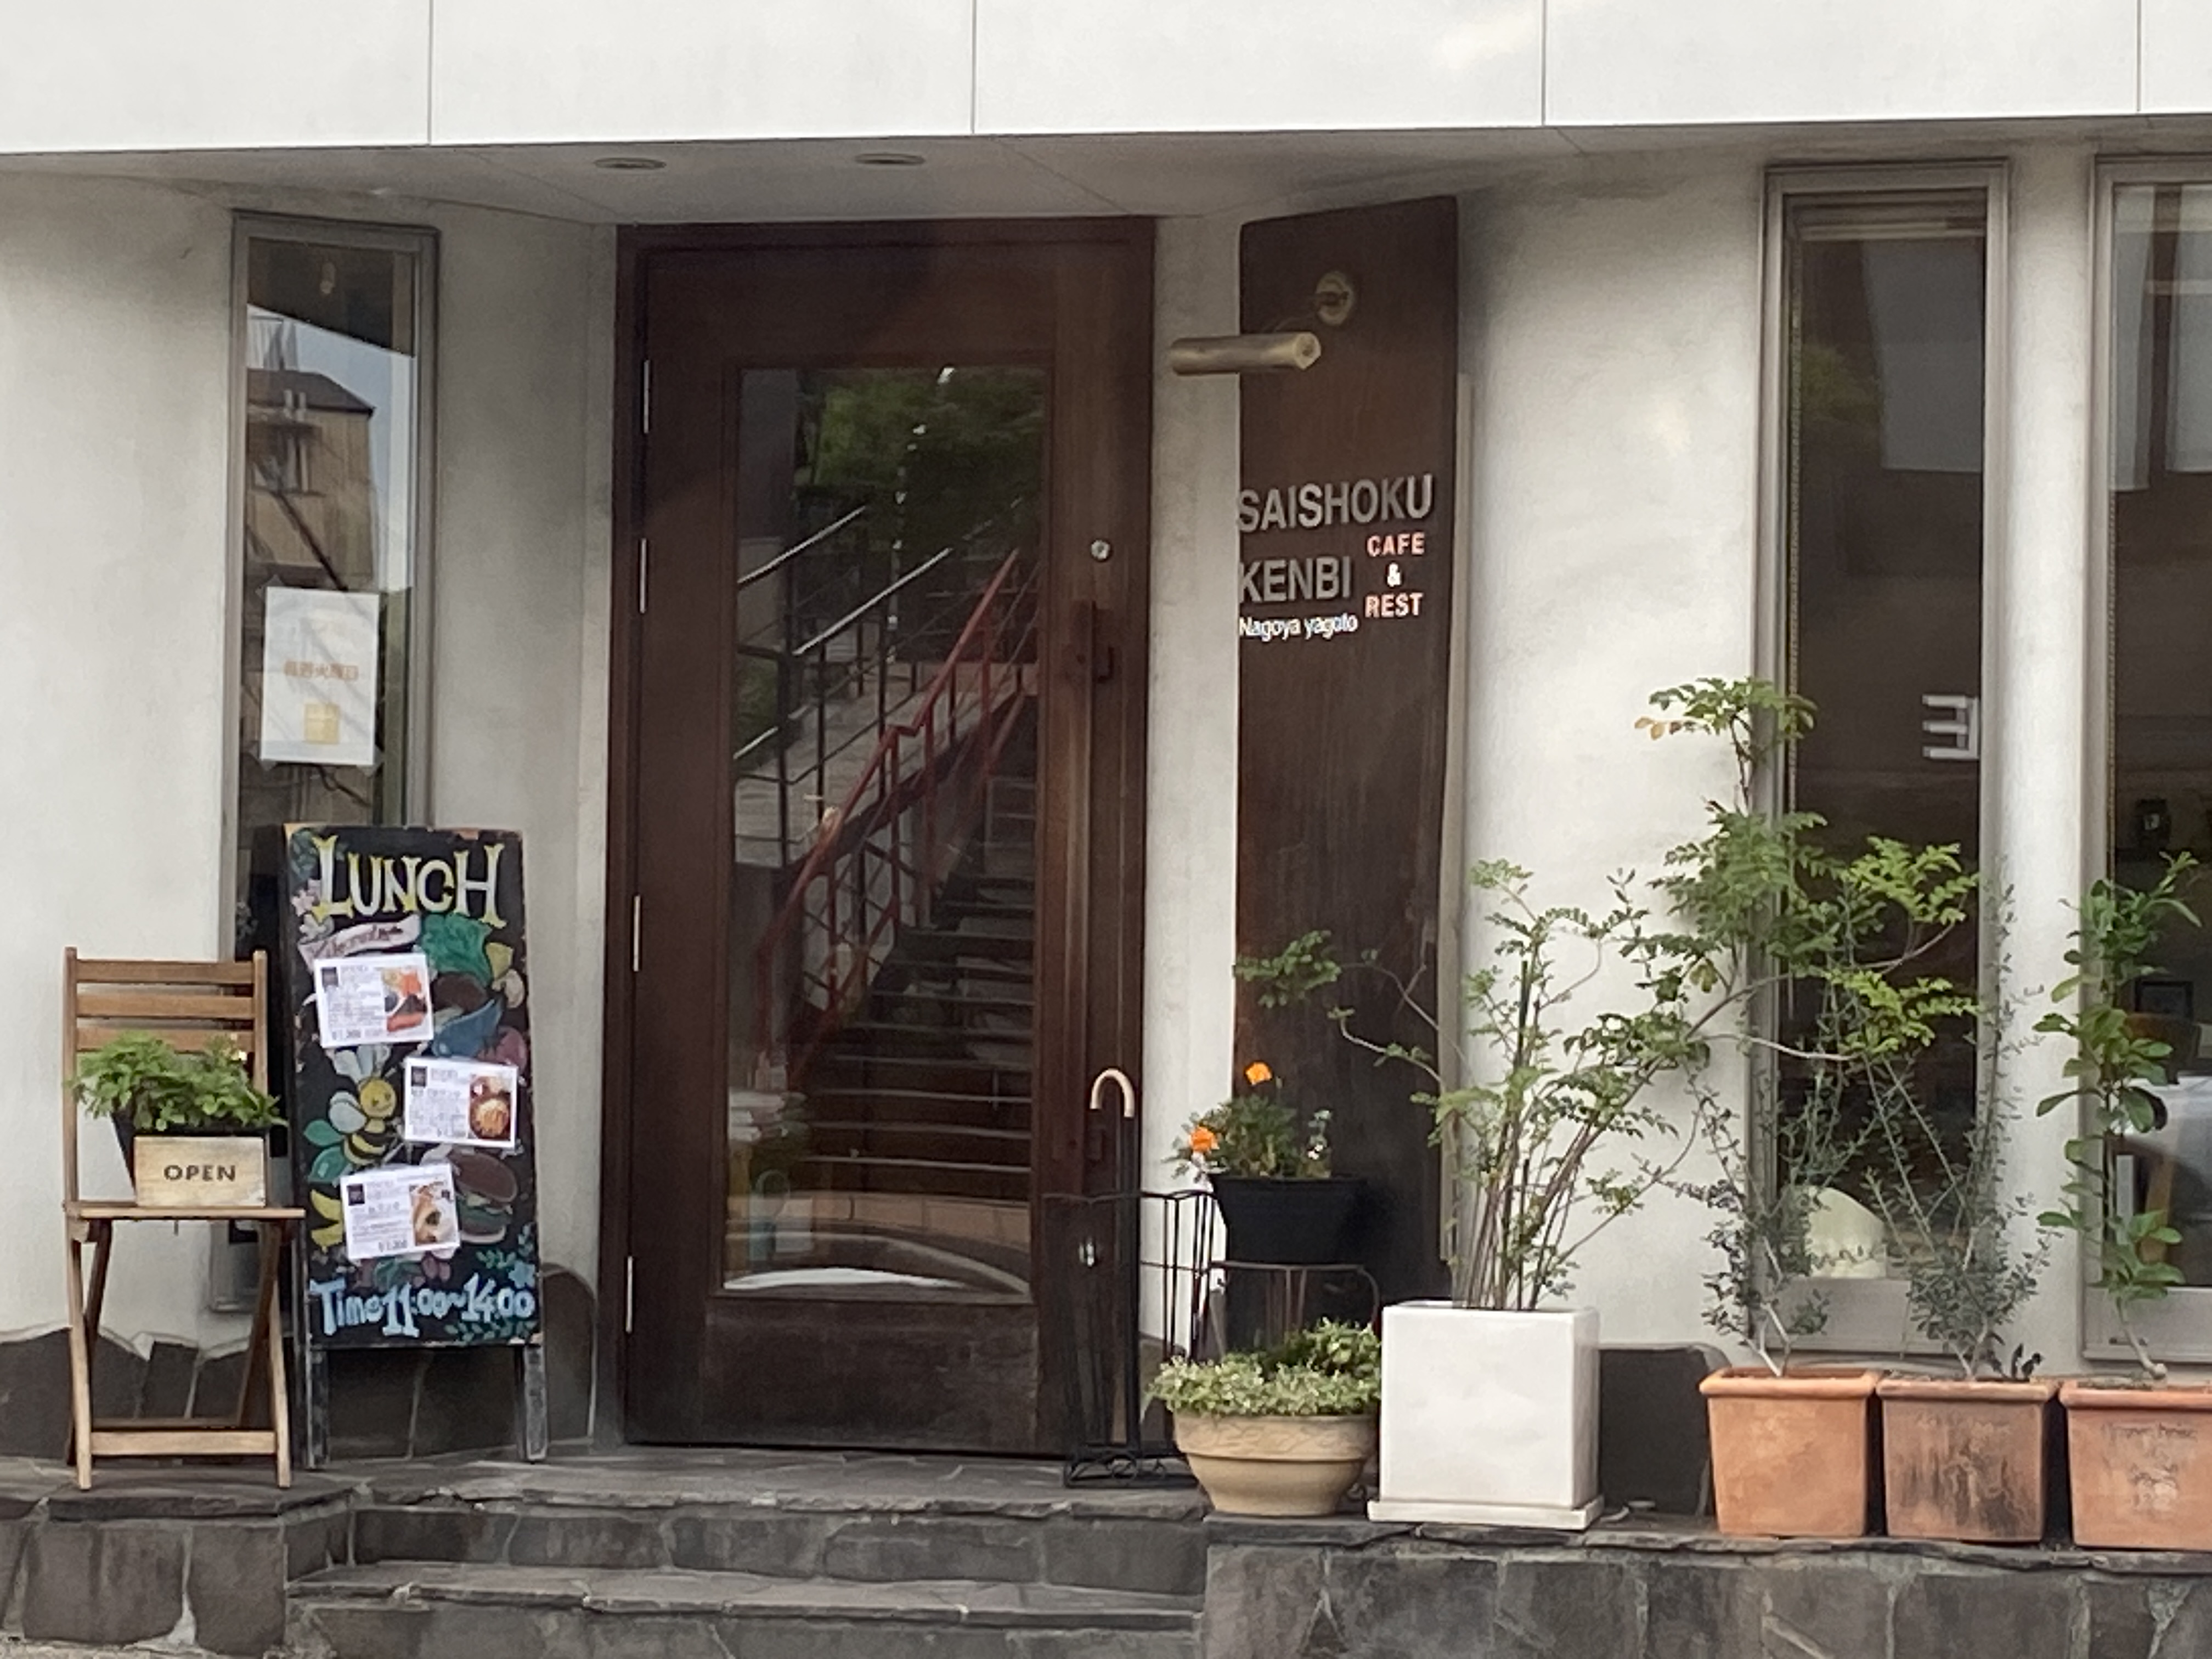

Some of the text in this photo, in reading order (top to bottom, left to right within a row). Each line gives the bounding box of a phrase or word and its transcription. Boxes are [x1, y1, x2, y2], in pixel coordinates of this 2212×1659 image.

[1238, 473, 1433, 533] SAISHOKU
[1367, 532, 1425, 557] CAFE
[1238, 556, 1351, 603] KENBI
[1386, 562, 1402, 587] &
[1365, 592, 1423, 618] REST
[1239, 616, 1301, 641] Nagoya
[311, 834, 507, 929] LUNCH
[163, 1164, 236, 1182] OPEN
[309, 1278, 383, 1336] Time
